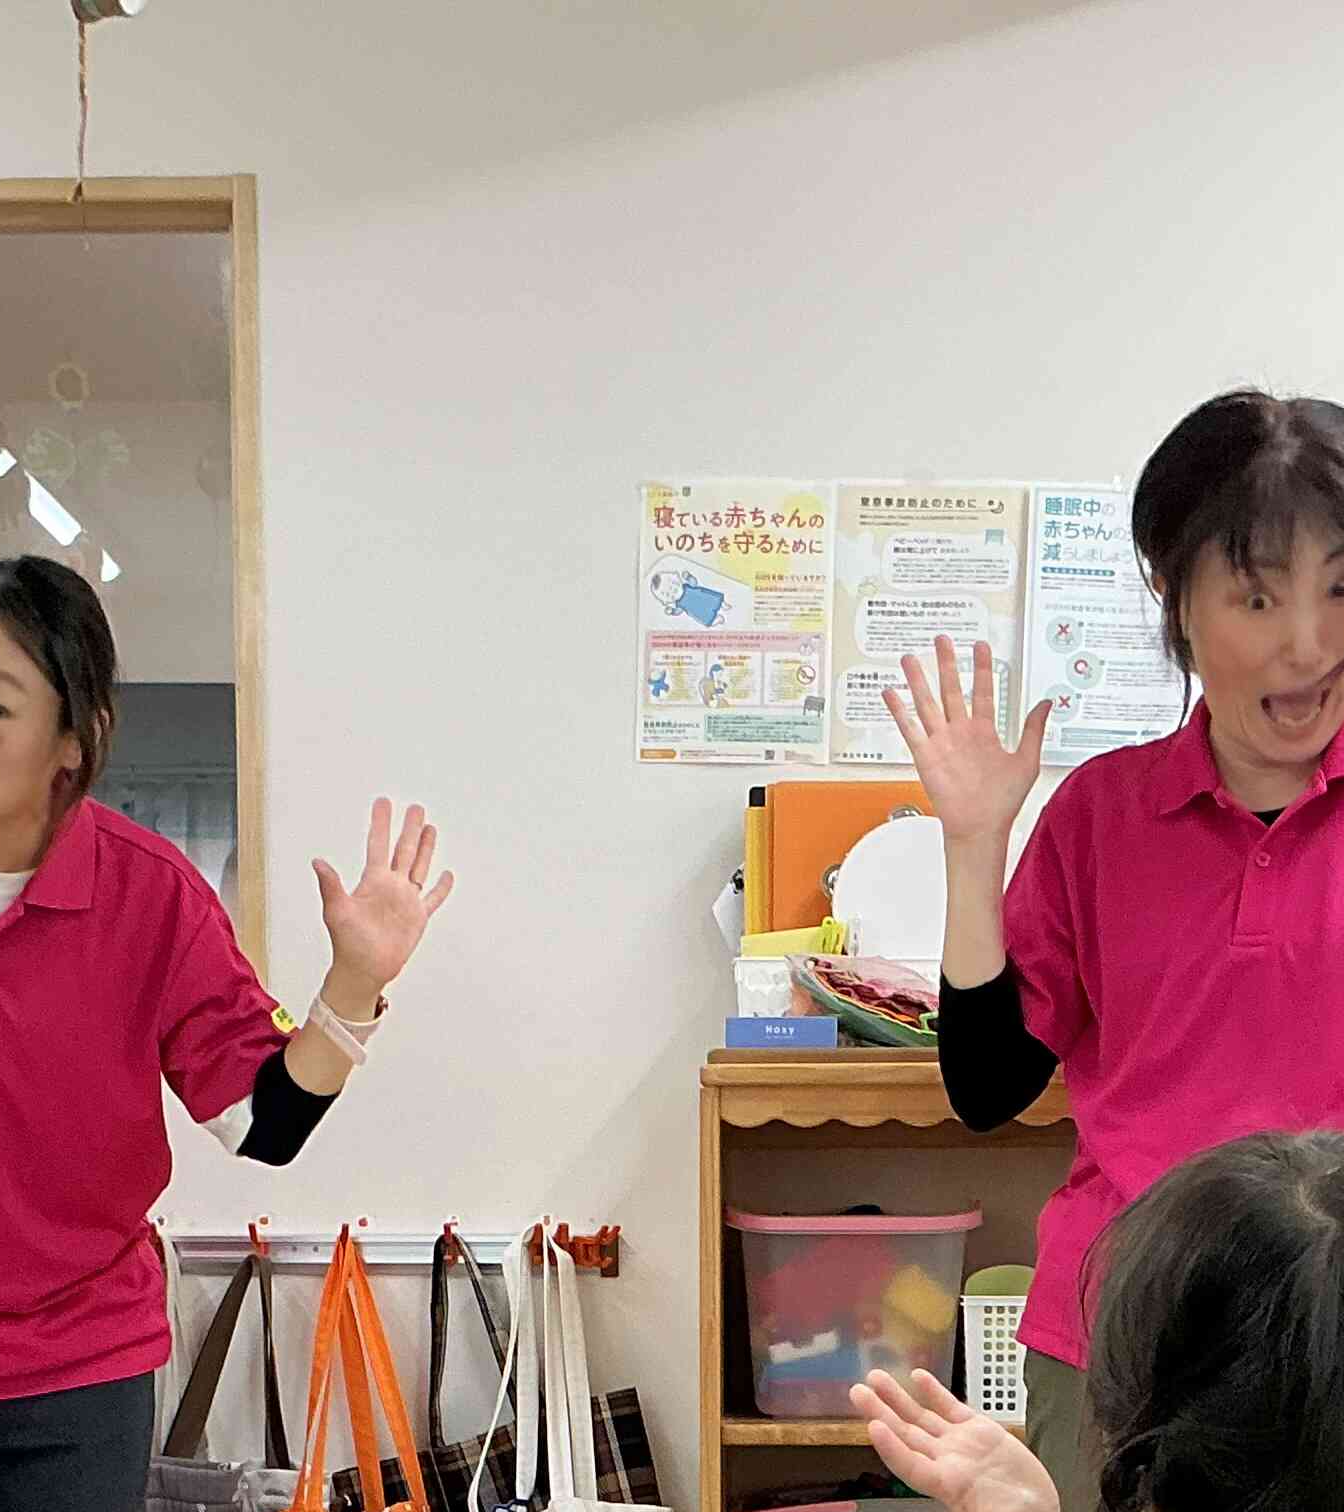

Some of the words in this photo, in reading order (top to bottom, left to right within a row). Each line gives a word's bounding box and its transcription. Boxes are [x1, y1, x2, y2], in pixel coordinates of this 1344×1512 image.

[654, 501, 825, 529] 寝ている赤ちゃんの
[1044, 497, 1115, 517] 睡眠中の
[654, 531, 824, 555] いのちを守るために
